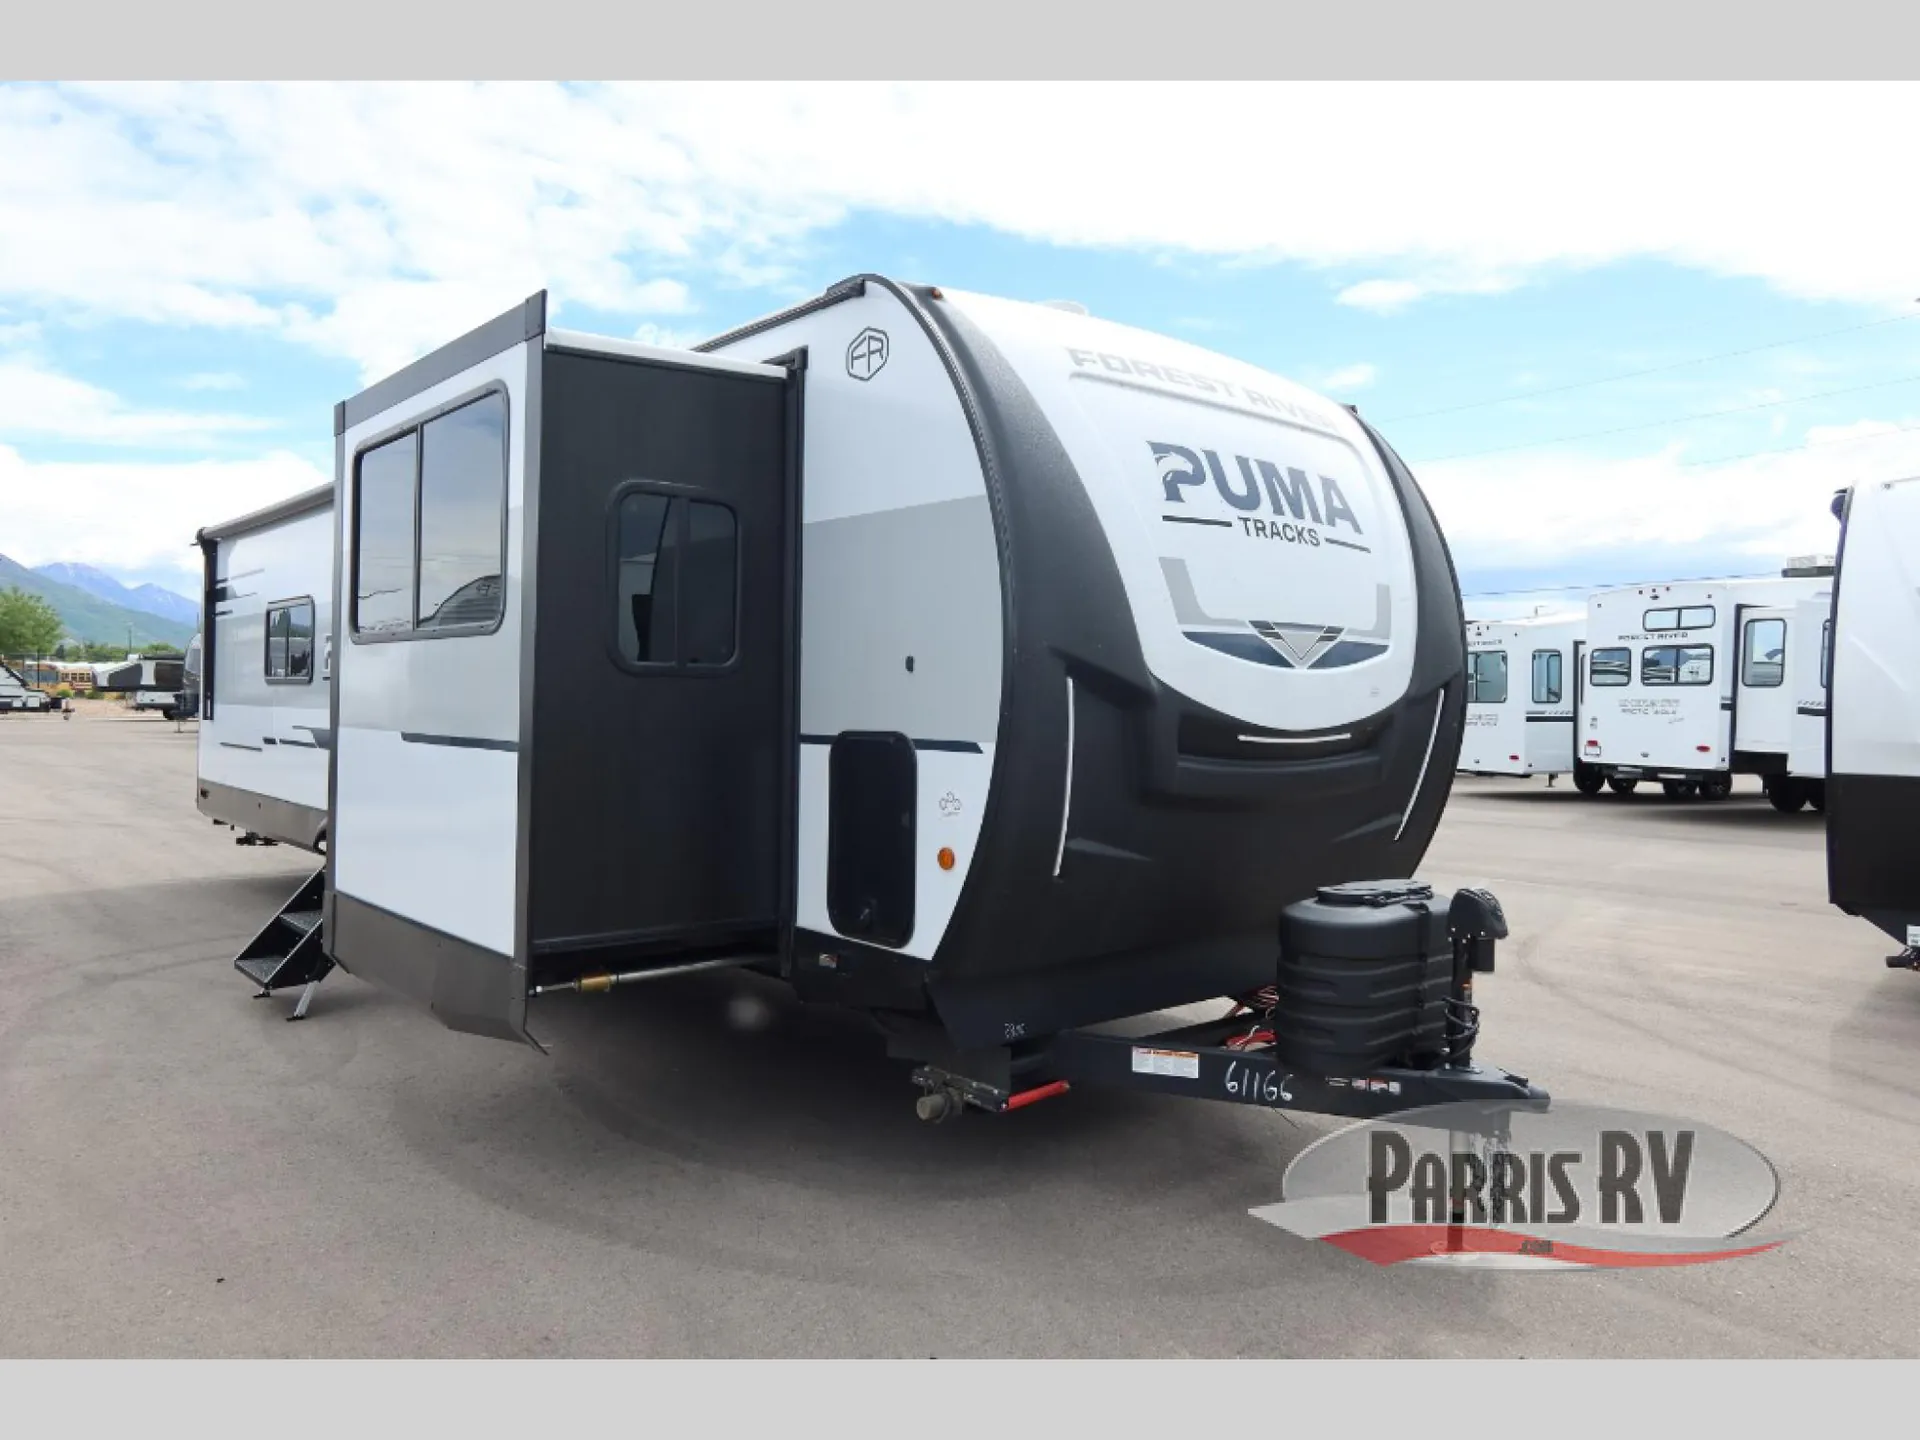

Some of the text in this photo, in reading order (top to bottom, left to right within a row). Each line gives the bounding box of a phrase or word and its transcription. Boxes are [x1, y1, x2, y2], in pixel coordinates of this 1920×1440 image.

[1067, 349, 1236, 398] FOREST
[1146, 441, 1363, 535] PUMA
[1238, 516, 1321, 547] TRACKS
[1225, 1060, 1294, 1101] 61166
